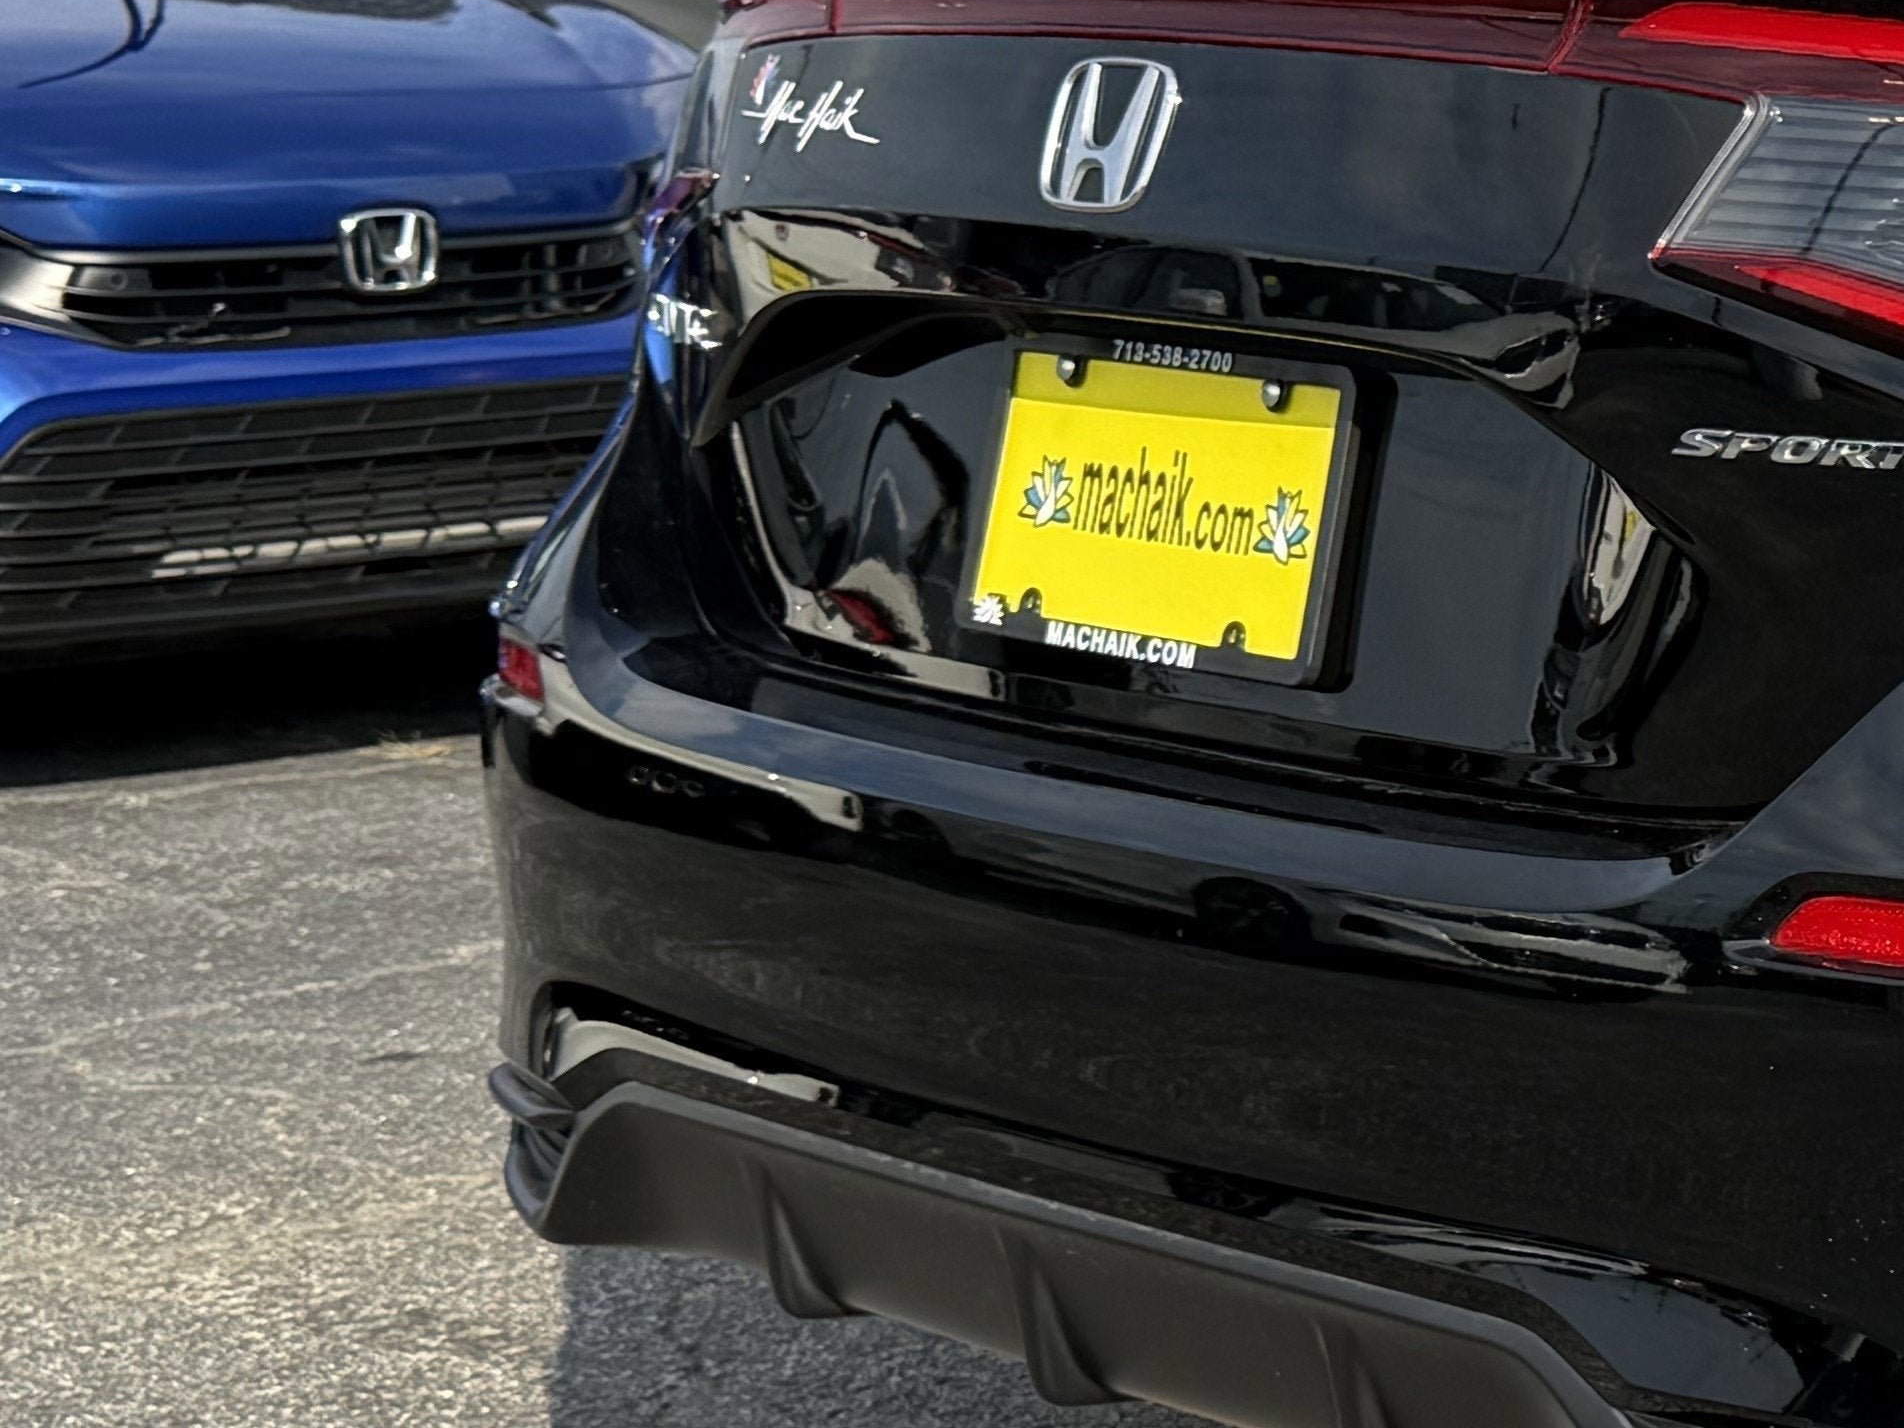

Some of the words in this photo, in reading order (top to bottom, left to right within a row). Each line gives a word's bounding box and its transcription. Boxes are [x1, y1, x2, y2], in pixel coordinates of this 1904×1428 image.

[1112, 339, 1233, 373] 713-538-2700
[1072, 446, 1255, 557] machaik.com
[1044, 621, 1198, 669] MACHAIK.COM
